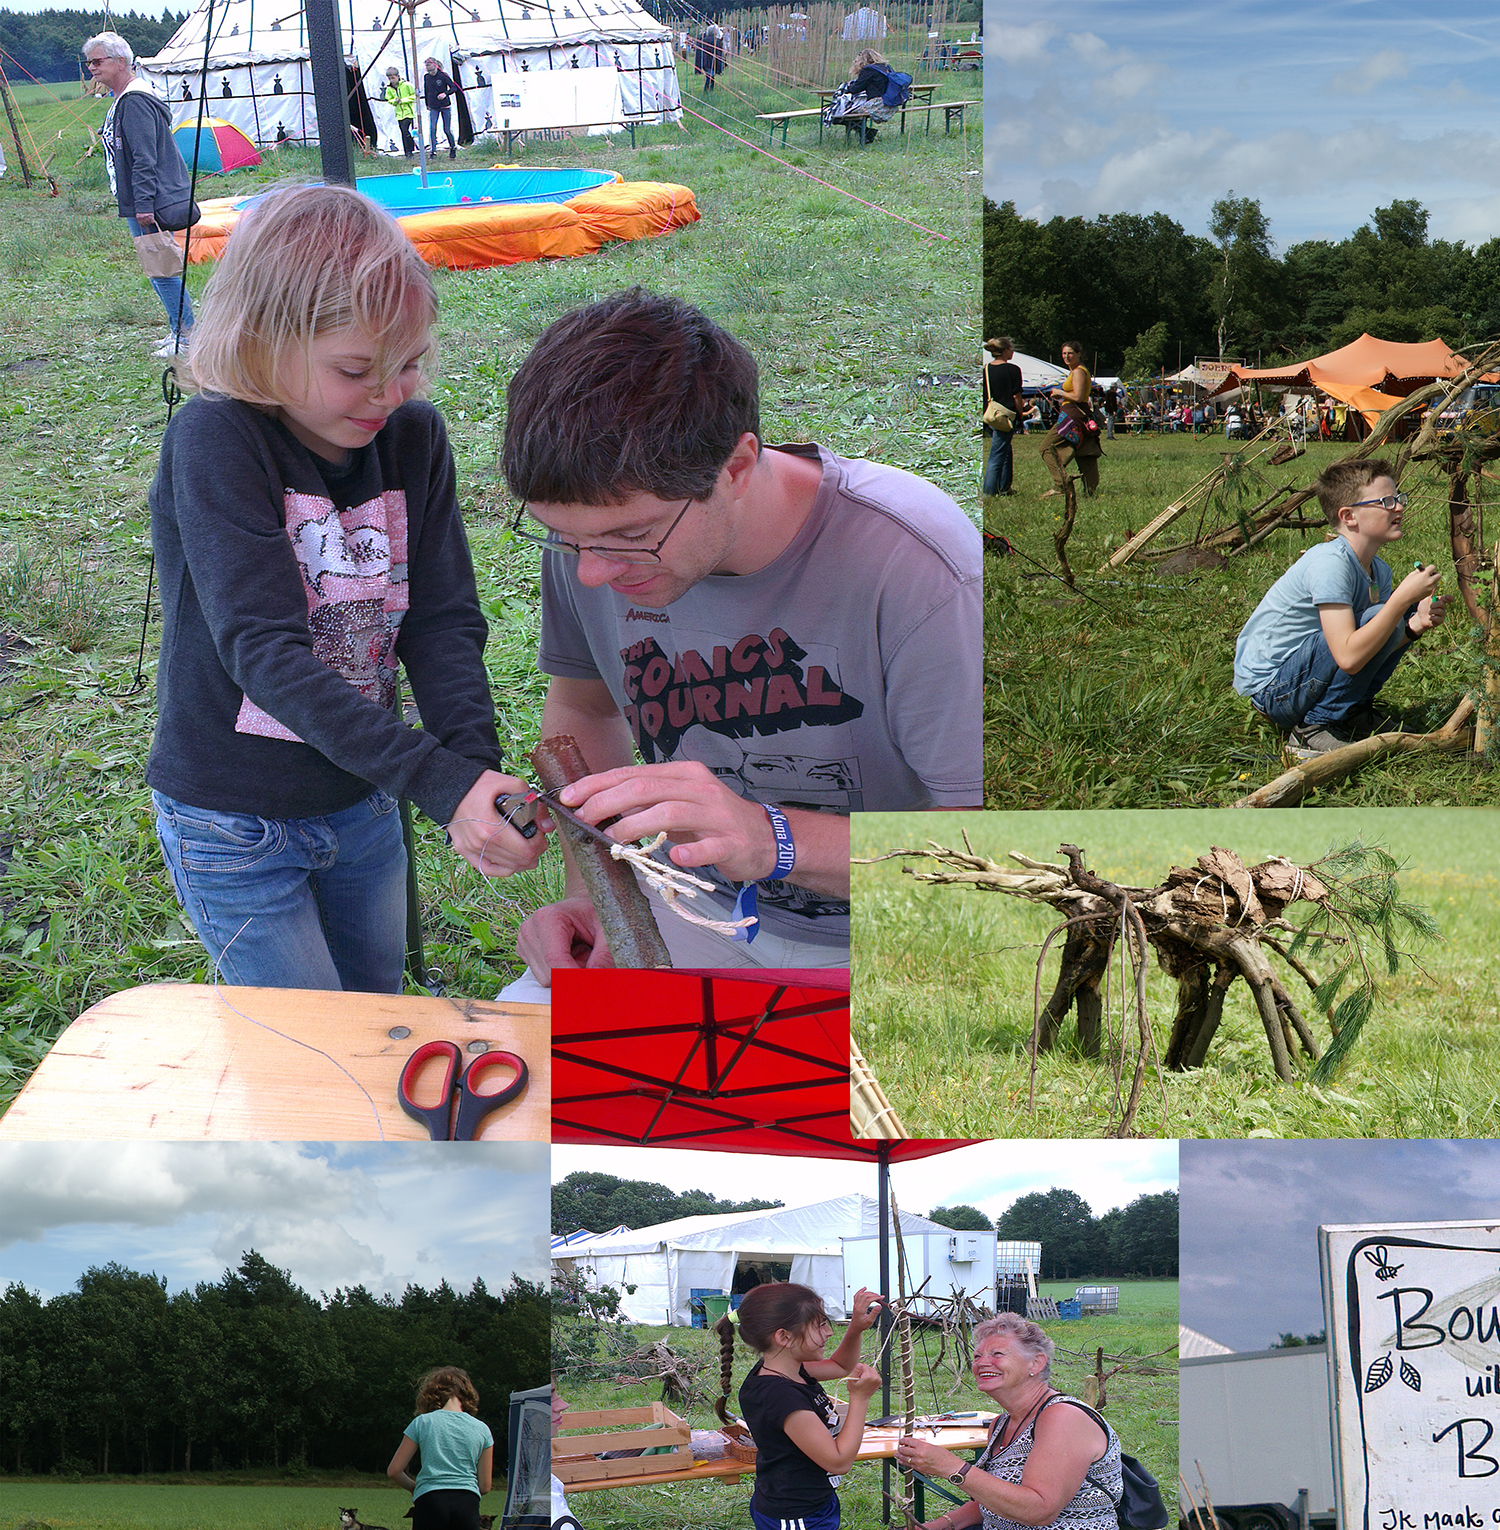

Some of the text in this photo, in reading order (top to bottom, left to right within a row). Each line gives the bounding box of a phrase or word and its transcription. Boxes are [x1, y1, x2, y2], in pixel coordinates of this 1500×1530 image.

[620, 637, 655, 662] THE
[623, 628, 789, 700] COMICS
[624, 666, 842, 747] JOURNAL
[770, 813, 787, 840] Kuna
[777, 843, 795, 871] 2017
